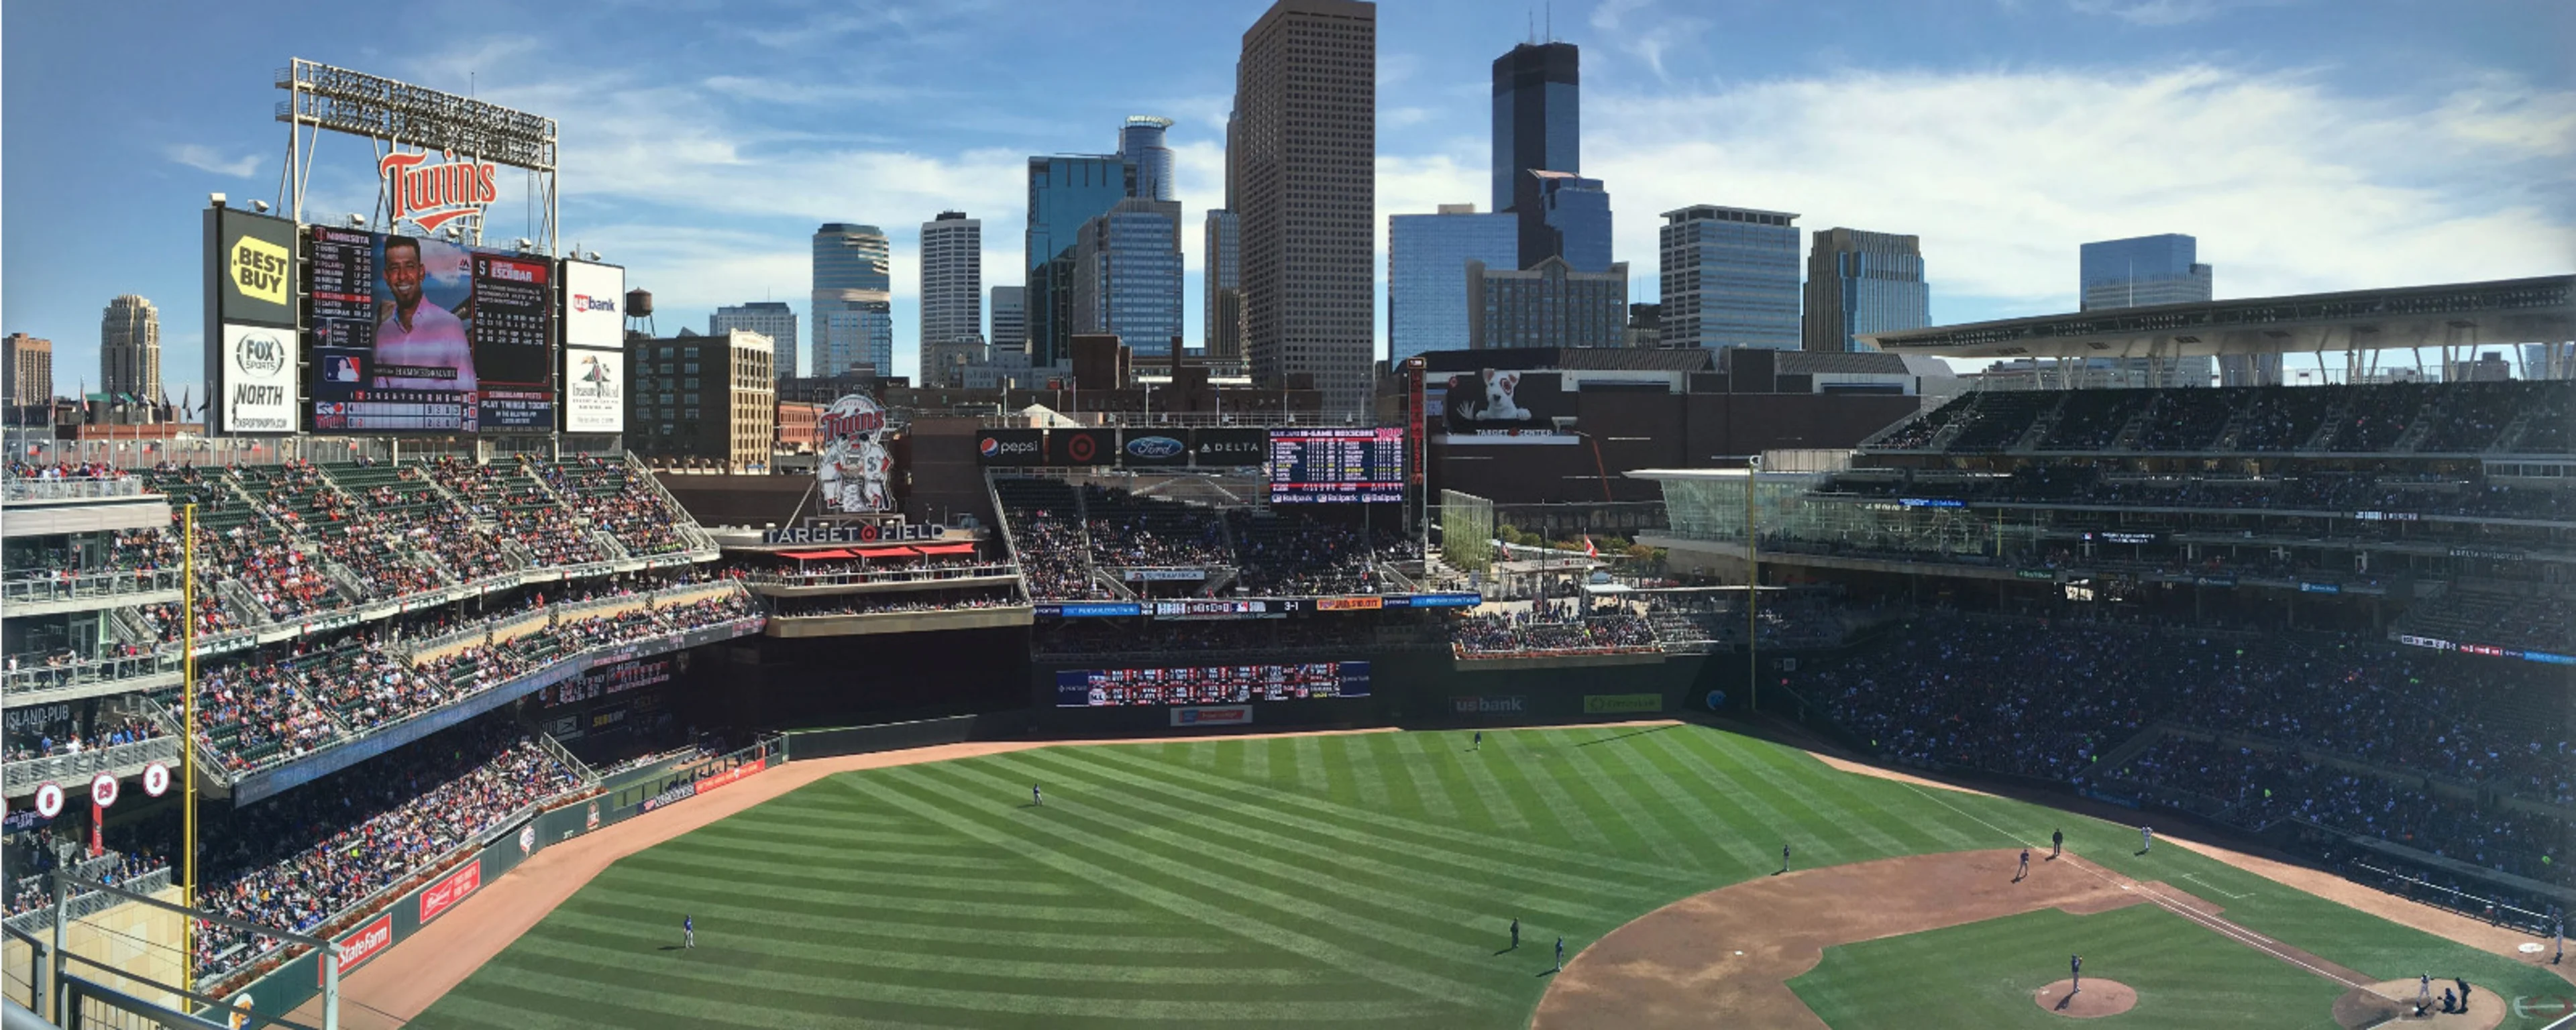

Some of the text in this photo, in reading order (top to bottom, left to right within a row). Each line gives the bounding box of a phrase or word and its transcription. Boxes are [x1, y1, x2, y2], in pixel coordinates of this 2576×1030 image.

[380, 147, 497, 222] Twins
[239, 246, 287, 276] BEST
[240, 266, 282, 293] BUY
[491, 268, 532, 282] ESCOBAR
[246, 339, 274, 361] FOX
[246, 360, 276, 371] SPORTS
[235, 383, 284, 406] NORTH
[820, 407, 885, 442] Twins
[1517, 429, 1554, 437] CENTER
[1001, 440, 1038, 453] pepsi
[1138, 437, 1173, 454] Ford
[1215, 443, 1258, 452] DELTA
[764, 523, 946, 544] TARGET FIELD
[1284, 602, 1298, 611] 3-1
[6, 705, 69, 727] ISLAND PUB
[592, 710, 626, 728] SUBWAY
[97, 781, 113, 800] 29
